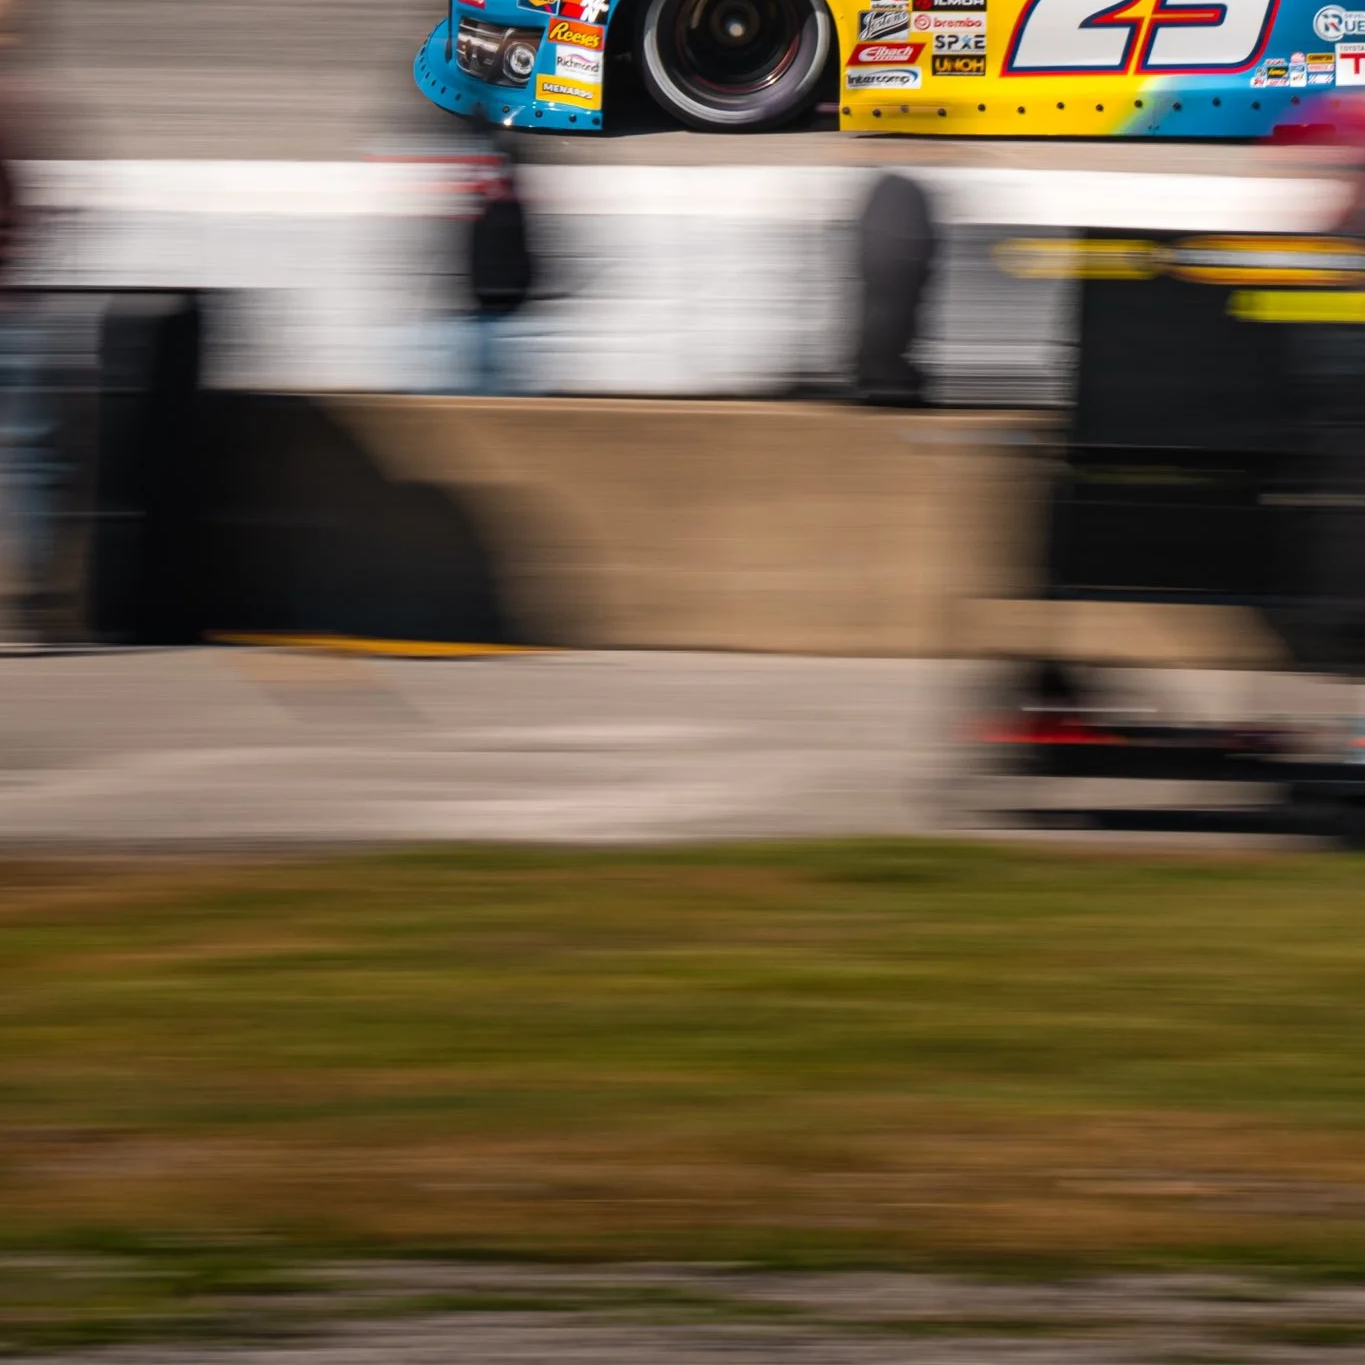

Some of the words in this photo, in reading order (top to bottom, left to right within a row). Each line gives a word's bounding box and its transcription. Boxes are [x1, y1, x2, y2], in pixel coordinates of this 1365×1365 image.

[934, 17, 981, 28] brembo
[550, 22, 601, 48] Reese's
[557, 55, 600, 73] Richmond
[935, 58, 984, 72] UNOH
[543, 83, 593, 99] MENARDS
